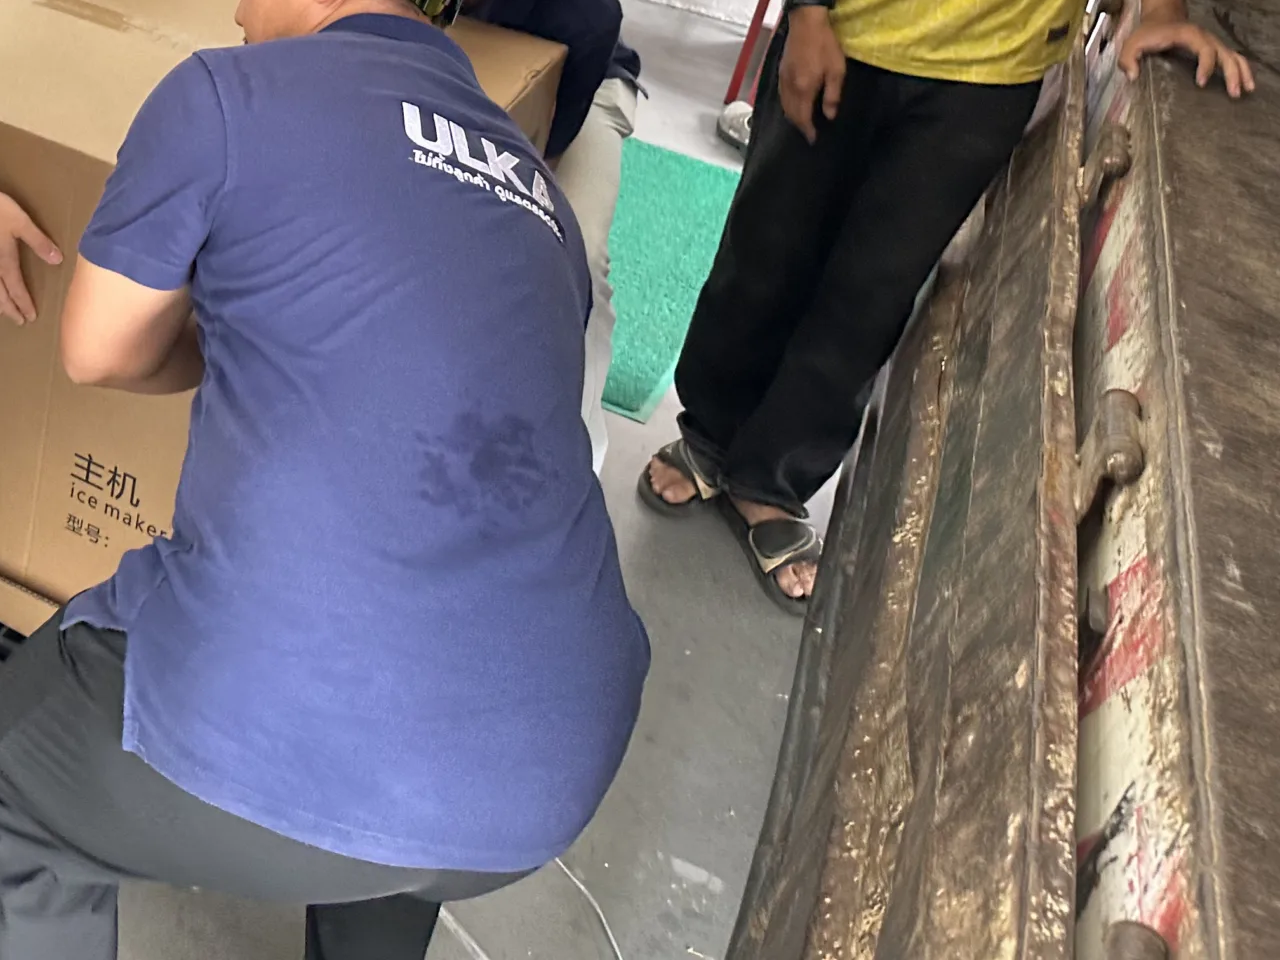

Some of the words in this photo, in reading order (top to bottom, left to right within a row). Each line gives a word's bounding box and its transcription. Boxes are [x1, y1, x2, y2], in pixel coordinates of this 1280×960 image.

[402, 101, 555, 213] ULKA
[70, 452, 141, 508] 主机
[70, 482, 98, 509] ice
[104, 502, 168, 539] maker
